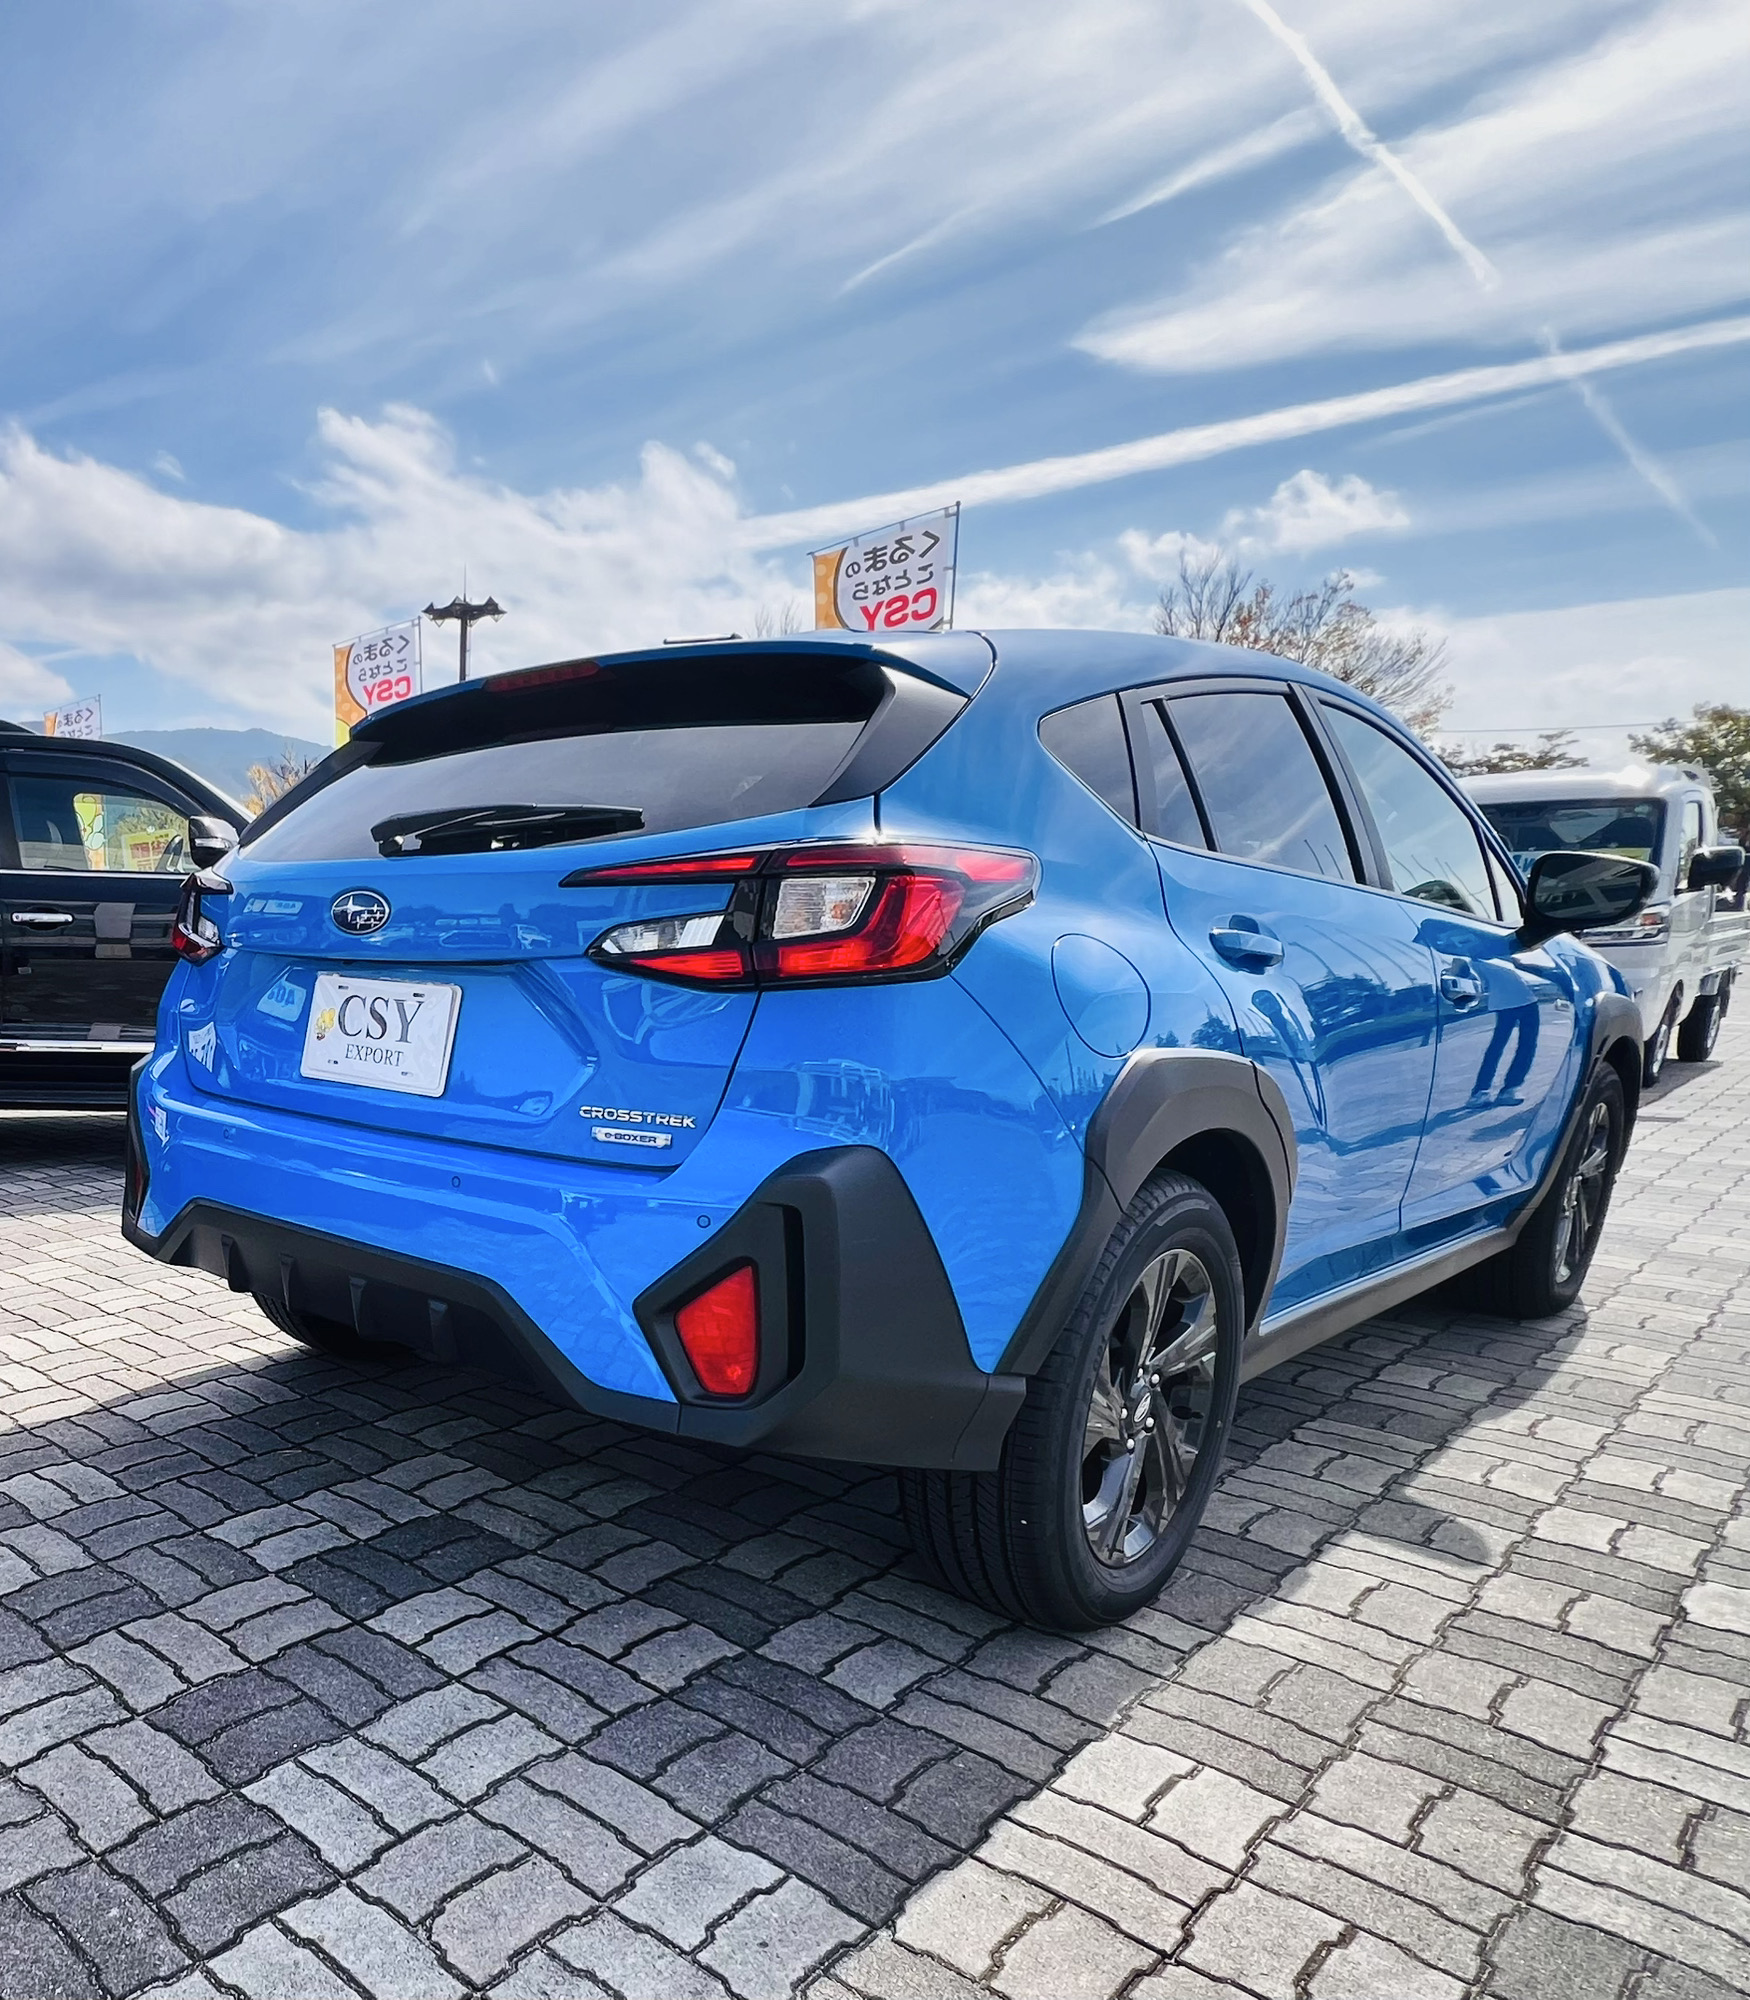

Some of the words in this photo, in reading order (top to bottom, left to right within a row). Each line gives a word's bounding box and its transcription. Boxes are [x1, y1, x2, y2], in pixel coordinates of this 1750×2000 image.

[338, 994, 425, 1044] CSY
[345, 1043, 404, 1067] EXPORT
[579, 1105, 697, 1129] CROSSTREK
[604, 1132, 657, 1144] e-BOXER
